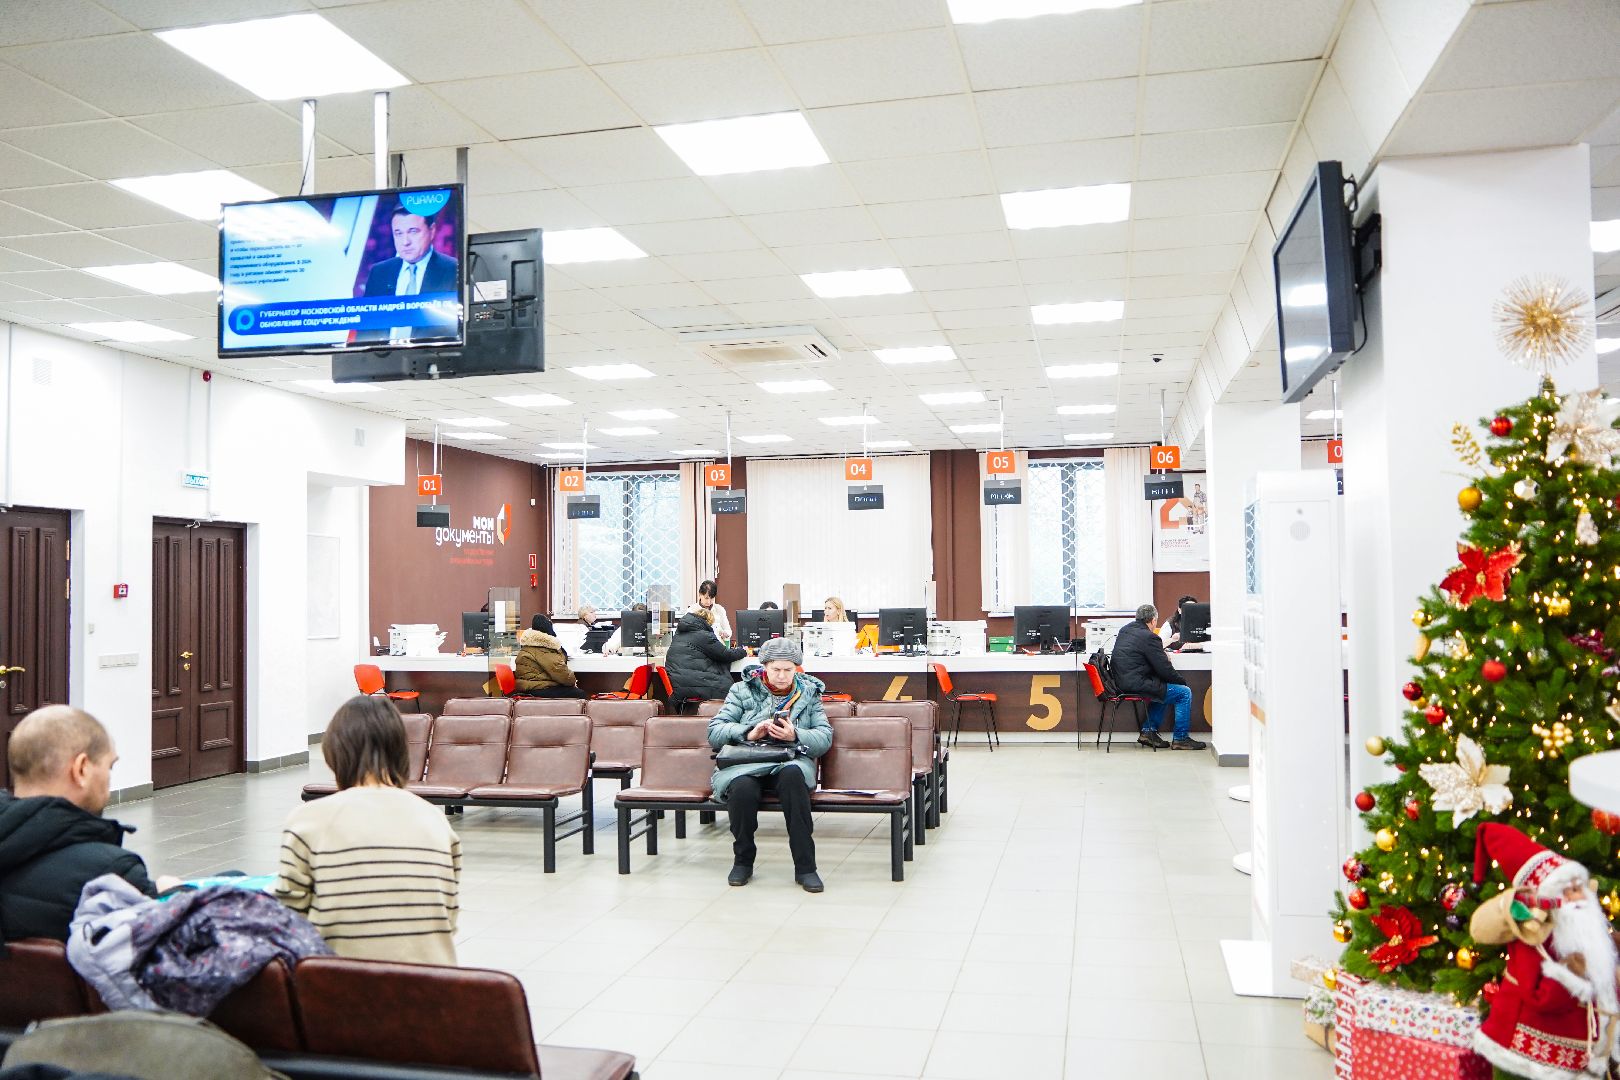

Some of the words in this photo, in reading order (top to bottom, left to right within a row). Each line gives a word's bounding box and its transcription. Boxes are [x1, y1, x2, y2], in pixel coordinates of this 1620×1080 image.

[260, 309, 300, 318] ГУБЕРНАТОР
[301, 305, 345, 316] МОСКОВСКОЙ
[346, 303, 377, 313] ОБЛАСТИ
[378, 302, 405, 312] АНДРЕЙ
[260, 319, 302, 329] ОБНОВЛЕНИИ
[303, 315, 361, 327] СОЦУЧРЕЖДЕНИЙ
[993, 456, 1009, 469] 05
[1157, 451, 1174, 464] 06
[710, 469, 726, 481] 03
[850, 463, 866, 476] 04
[423, 479, 437, 491] 01
[564, 475, 579, 487] 02
[435, 526, 495, 548] документы
[1025, 674, 1063, 731] 5
